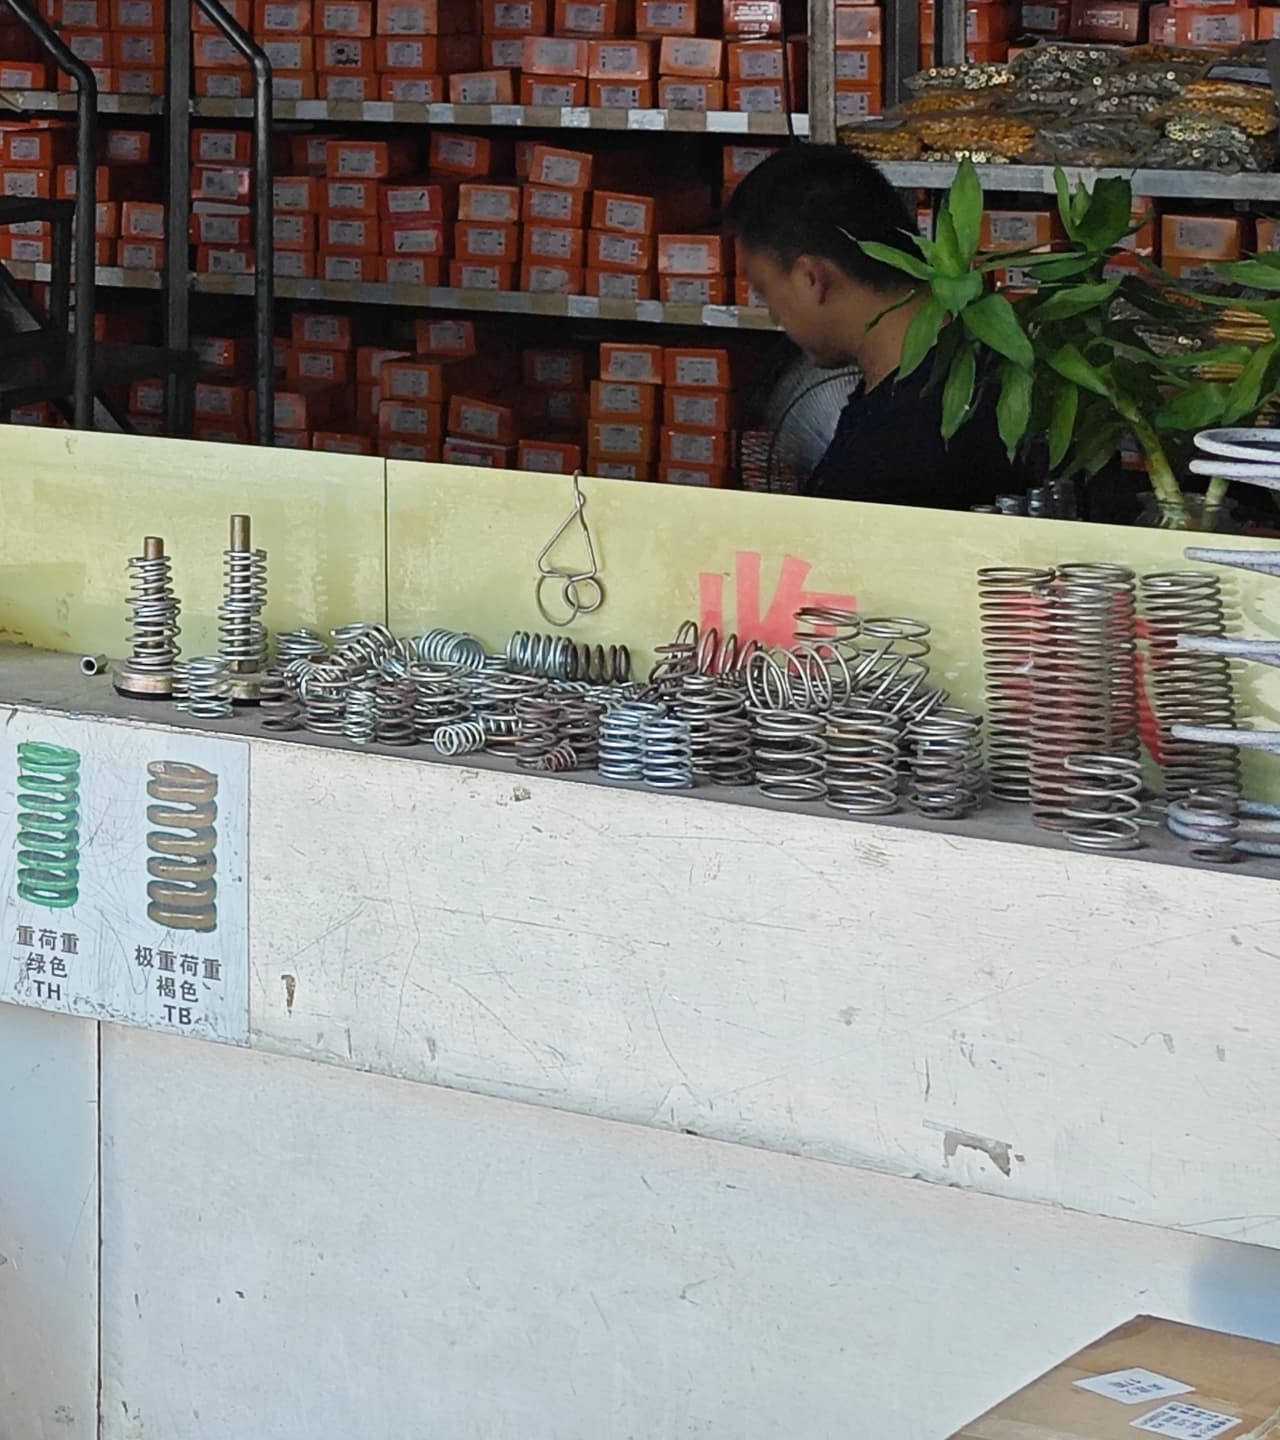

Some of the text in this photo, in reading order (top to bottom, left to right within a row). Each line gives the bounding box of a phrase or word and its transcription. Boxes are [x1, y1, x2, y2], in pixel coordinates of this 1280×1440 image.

[15, 924, 80, 955] 重荷重
[26, 951, 68, 979] 绿色
[134, 943, 223, 982] 极重荷重
[32, 979, 62, 1001] TH
[156, 974, 200, 1003] 褐色
[163, 1005, 192, 1025] TB
